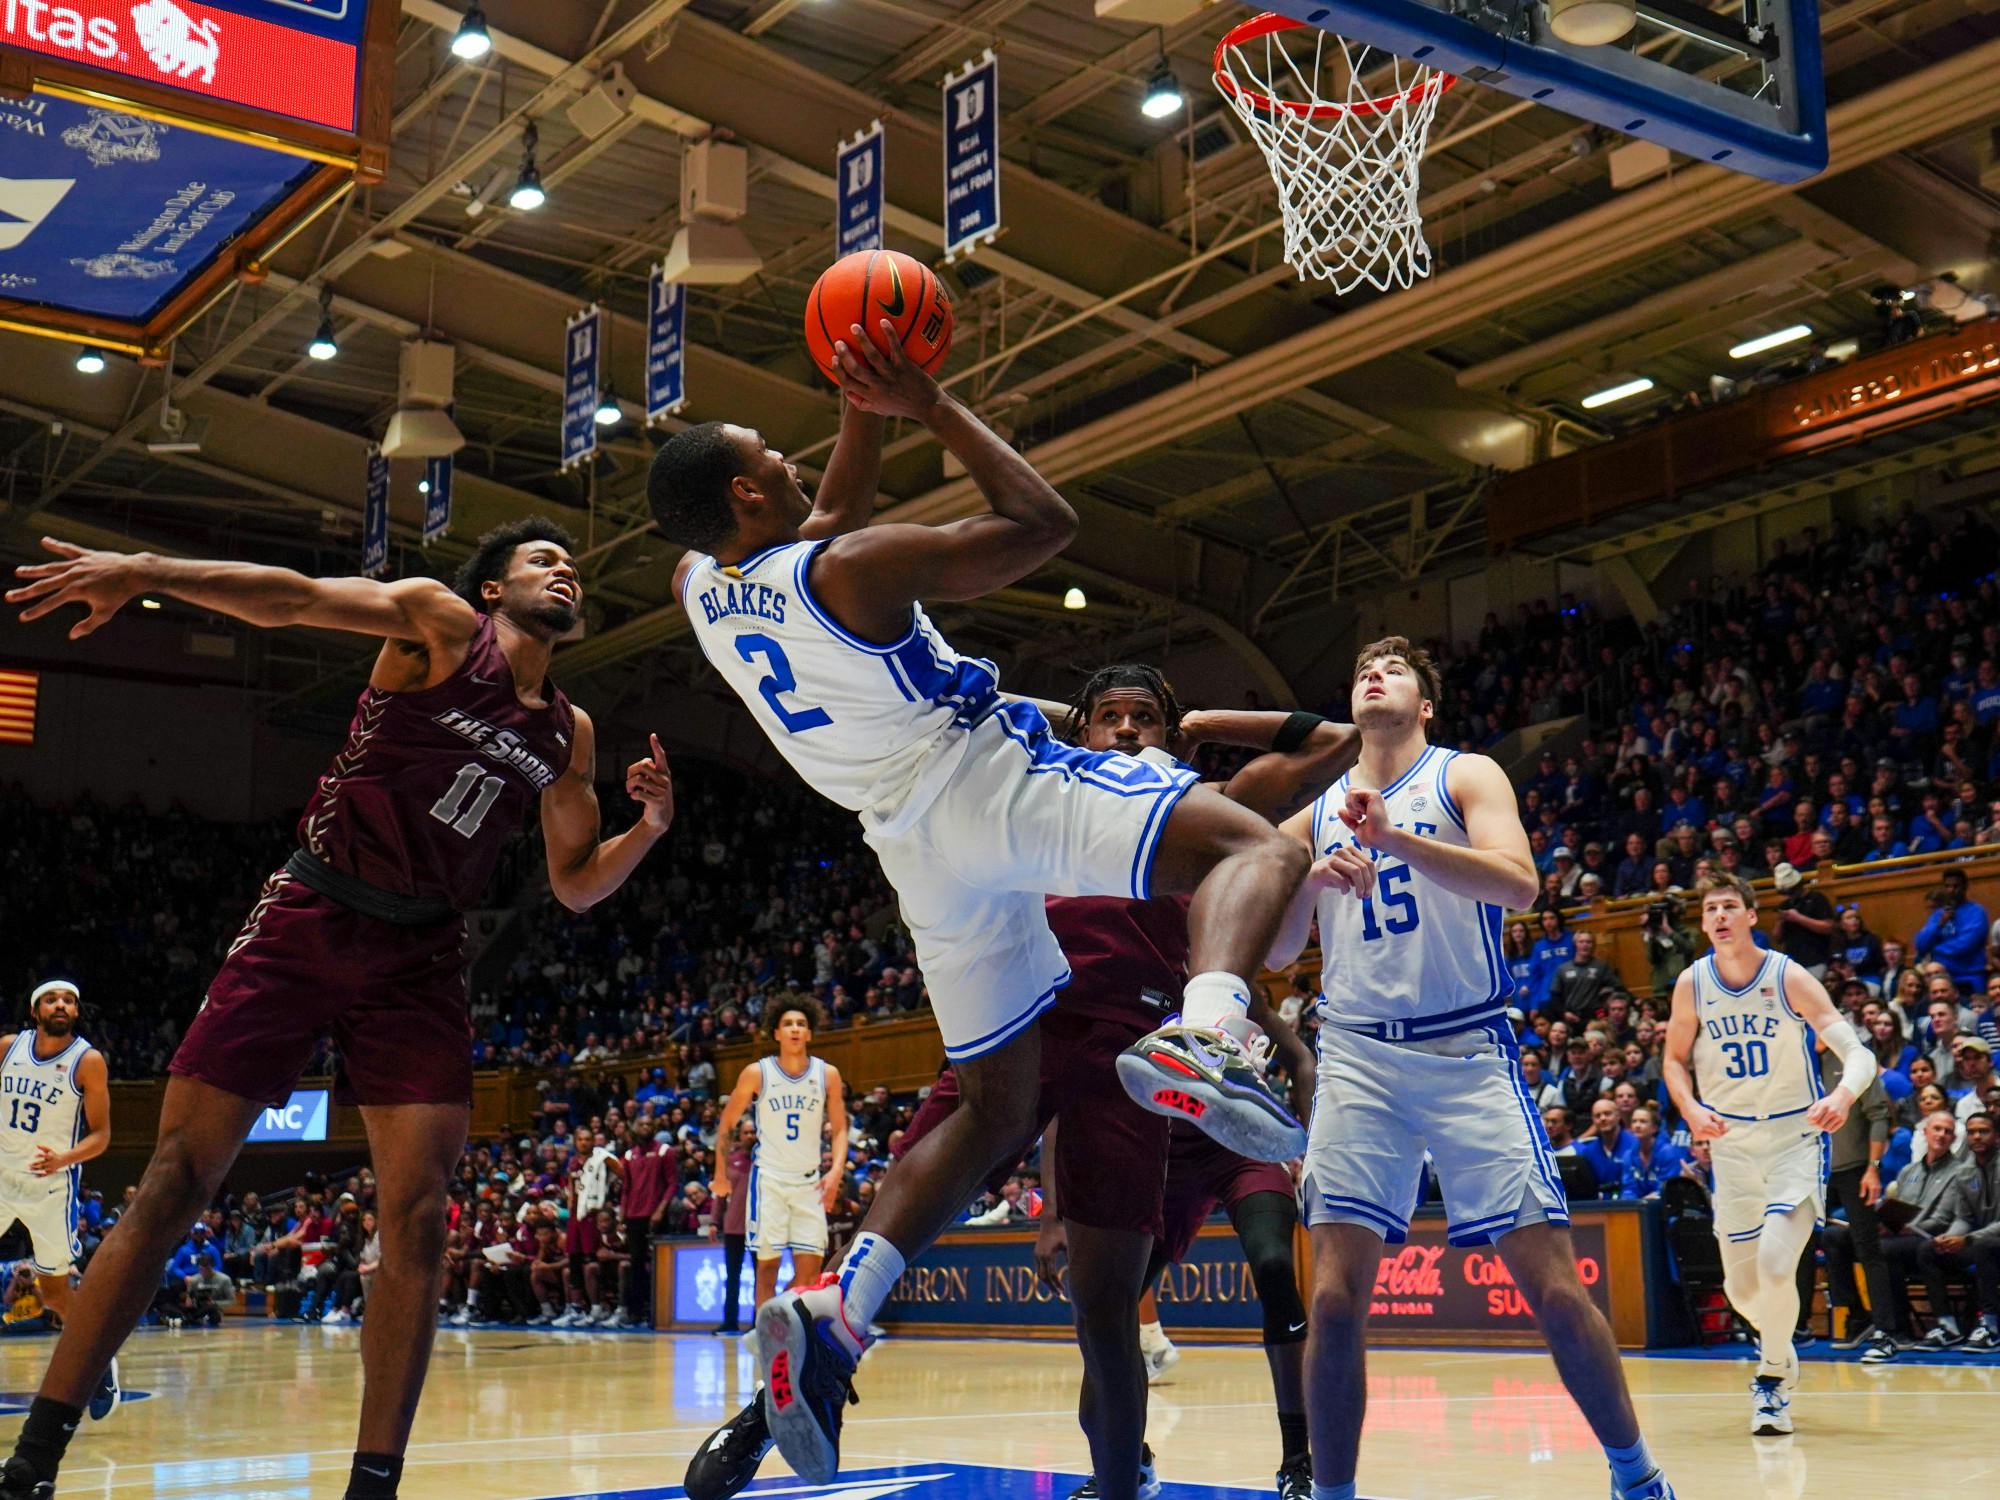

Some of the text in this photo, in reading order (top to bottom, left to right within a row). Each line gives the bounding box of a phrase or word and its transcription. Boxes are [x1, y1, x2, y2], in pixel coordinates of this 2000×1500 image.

[699, 583, 787, 625] BLAKES
[734, 633, 834, 734] 2
[439, 711, 555, 789] THE SHORE
[429, 763, 507, 839] 11
[1361, 863, 1420, 941] 15
[1706, 1014, 1779, 1040] DUKE
[1721, 1041, 1769, 1079] 30
[4, 1076, 63, 1105] DUKE
[768, 1095, 819, 1112] DUKE
[9, 1098, 41, 1133] 13
[265, 1104, 303, 1130] NC
[786, 1113, 800, 1141] 5
[889, 1266, 970, 1302] ERON
